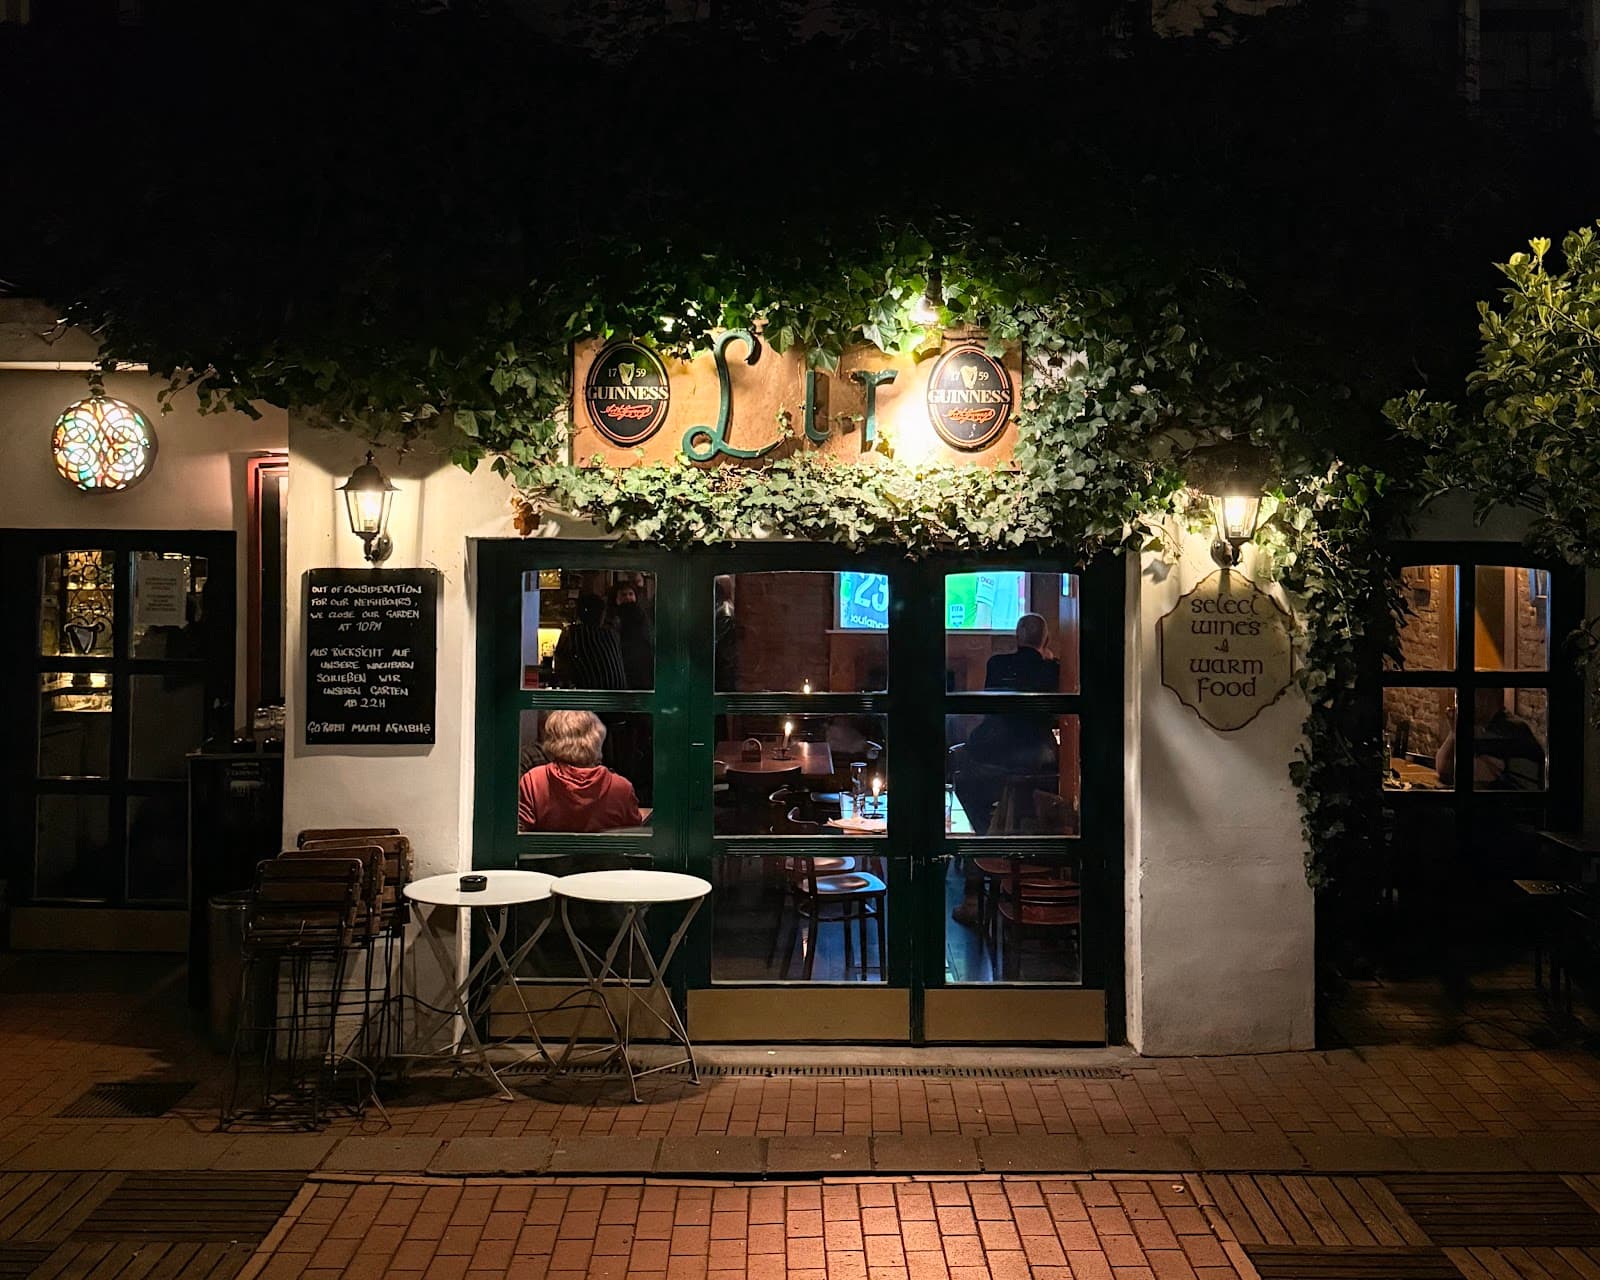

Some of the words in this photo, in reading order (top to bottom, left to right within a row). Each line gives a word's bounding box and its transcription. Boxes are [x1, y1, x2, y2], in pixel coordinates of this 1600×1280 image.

[608, 368, 617, 377] 17
[635, 368, 647, 378] 59
[978, 372, 990, 381] 59
[587, 386, 669, 400] GUINNESS
[928, 389, 1010, 403] GUINNESS
[344, 584, 422, 594] CONSIDERATION
[312, 598, 327, 606] FOR
[330, 598, 349, 606] OUR
[1191, 593, 1259, 615] select
[328, 610, 355, 618] CLOSE
[361, 610, 380, 618] OUR
[386, 609, 420, 619] GARDEN
[338, 623, 352, 631] AT
[356, 621, 382, 631] 10PM
[1191, 620, 1261, 636] wines
[310, 648, 328, 657] AUS
[392, 648, 411, 657] AUF
[320, 661, 360, 669] UNSERE
[378, 674, 401, 682] WIR
[323, 686, 361, 695] UNSEREN
[370, 685, 409, 696] GARTEN
[1197, 676, 1256, 703] food
[344, 699, 357, 708] AB
